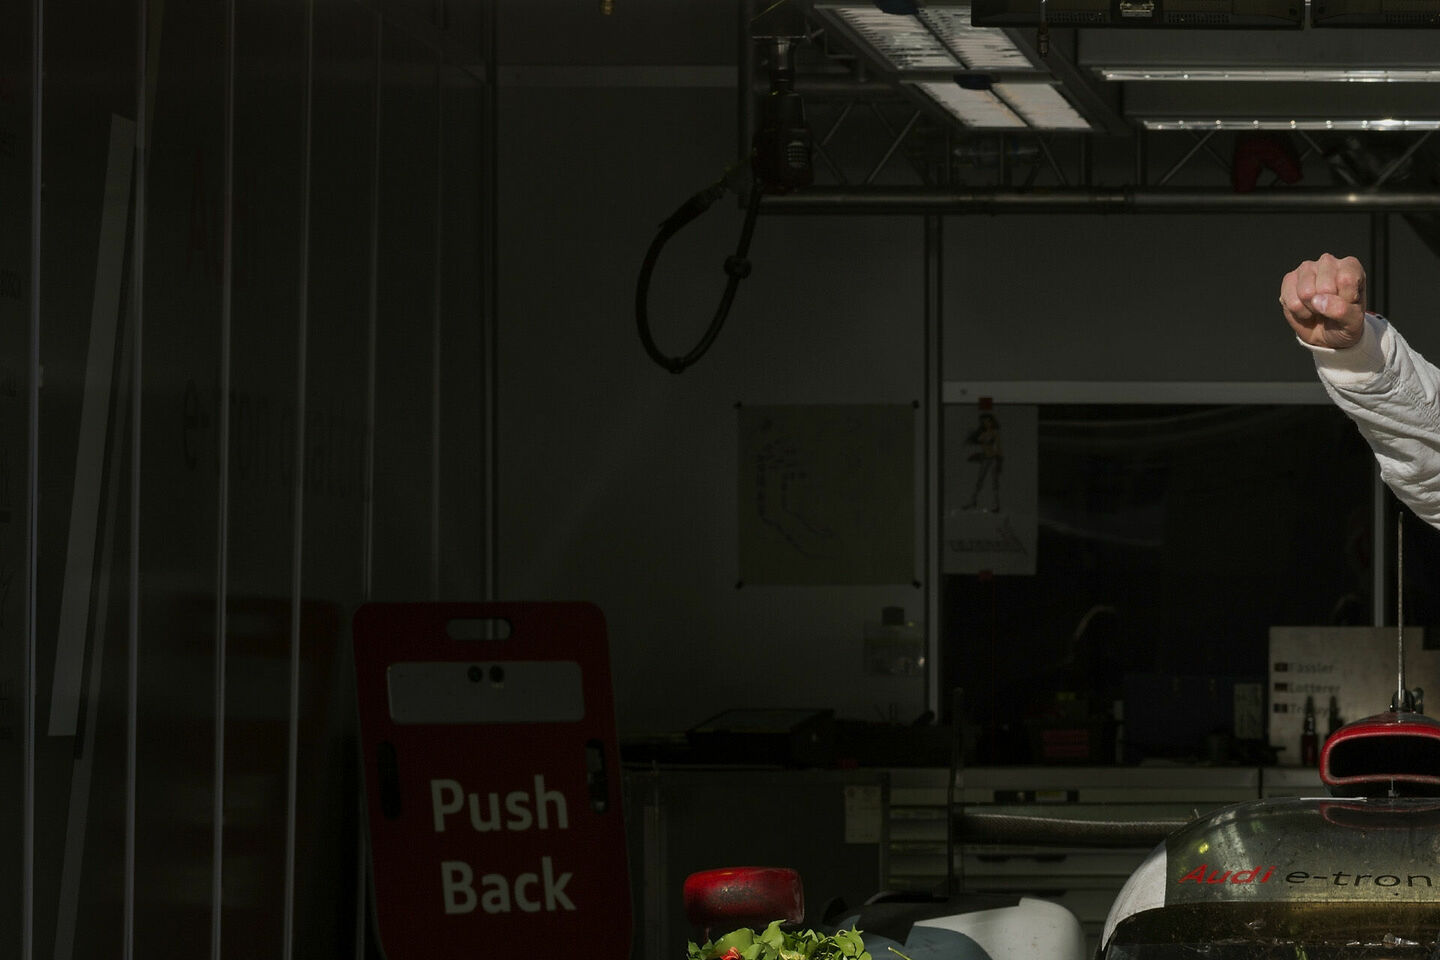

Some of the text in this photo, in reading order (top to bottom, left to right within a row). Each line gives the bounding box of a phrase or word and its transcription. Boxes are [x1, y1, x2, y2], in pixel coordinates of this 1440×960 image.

[430, 774, 569, 832] Push
[441, 856, 577, 914] Back
[1178, 863, 1277, 885] Audi
[1285, 868, 1433, 888] e-tron
